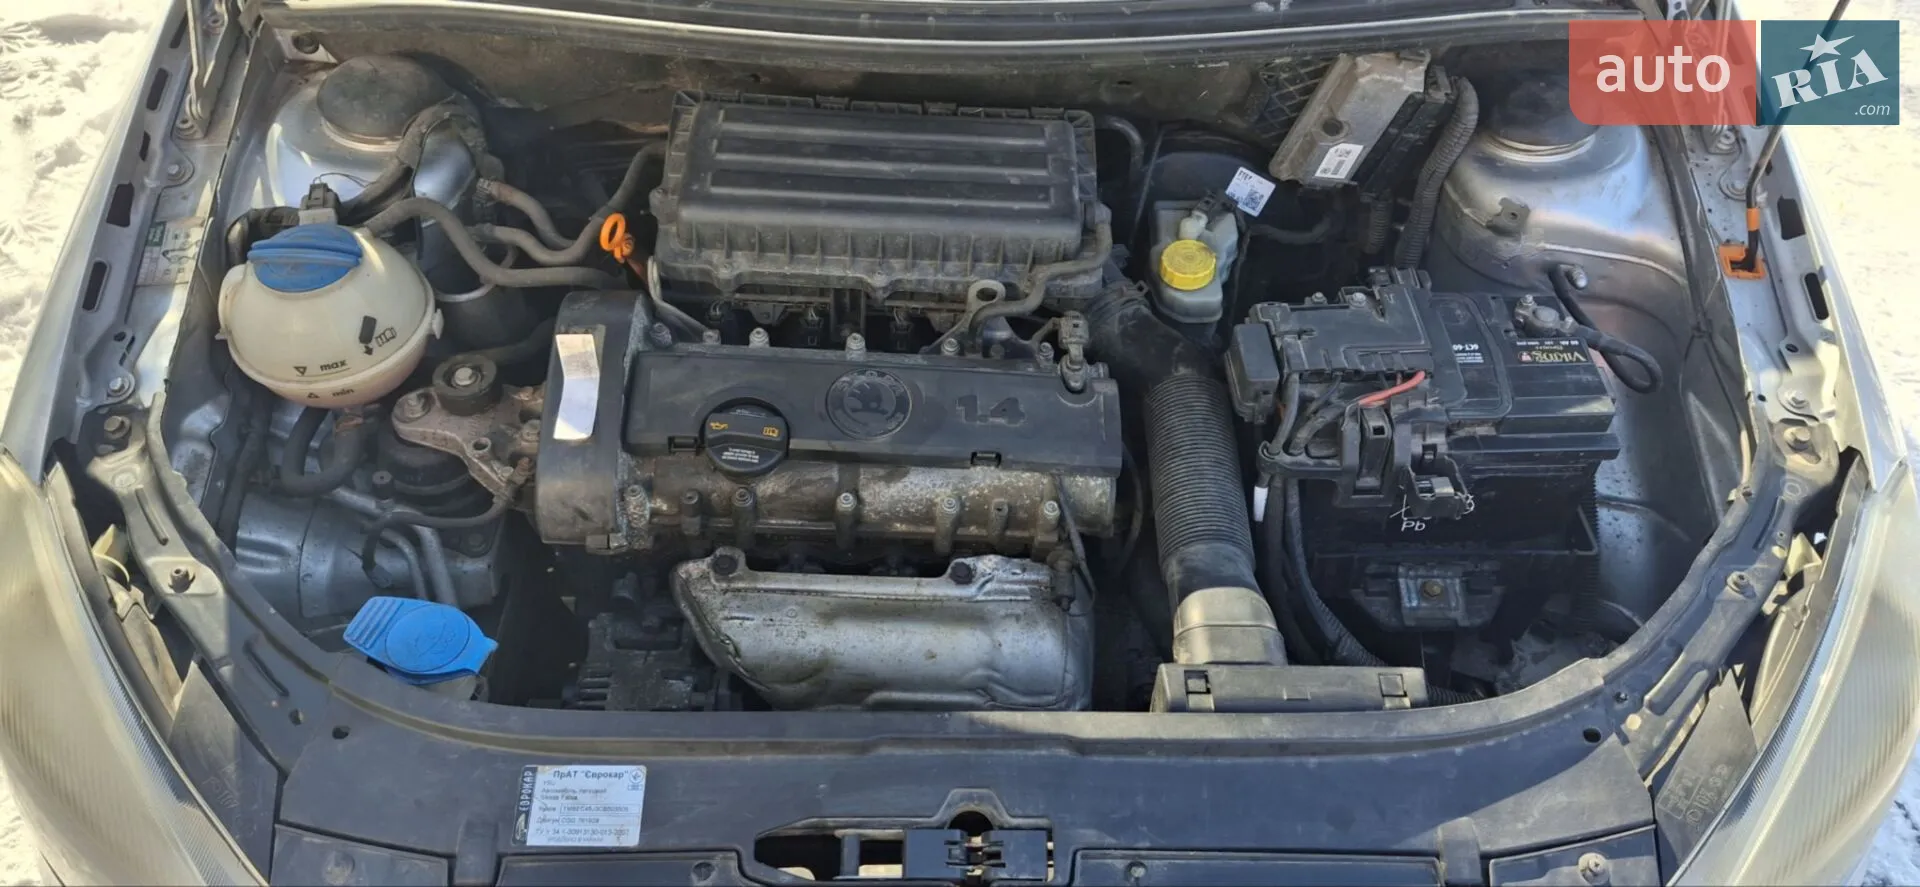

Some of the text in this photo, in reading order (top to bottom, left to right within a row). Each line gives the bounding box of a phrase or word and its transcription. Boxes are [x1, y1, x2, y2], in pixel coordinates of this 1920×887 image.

[319, 360, 347, 371] max
[332, 388, 355, 398] min
[956, 394, 1026, 427] 1.4
[1401, 520, 1426, 532] Pb
[553, 770, 578, 779] ПрАТ
